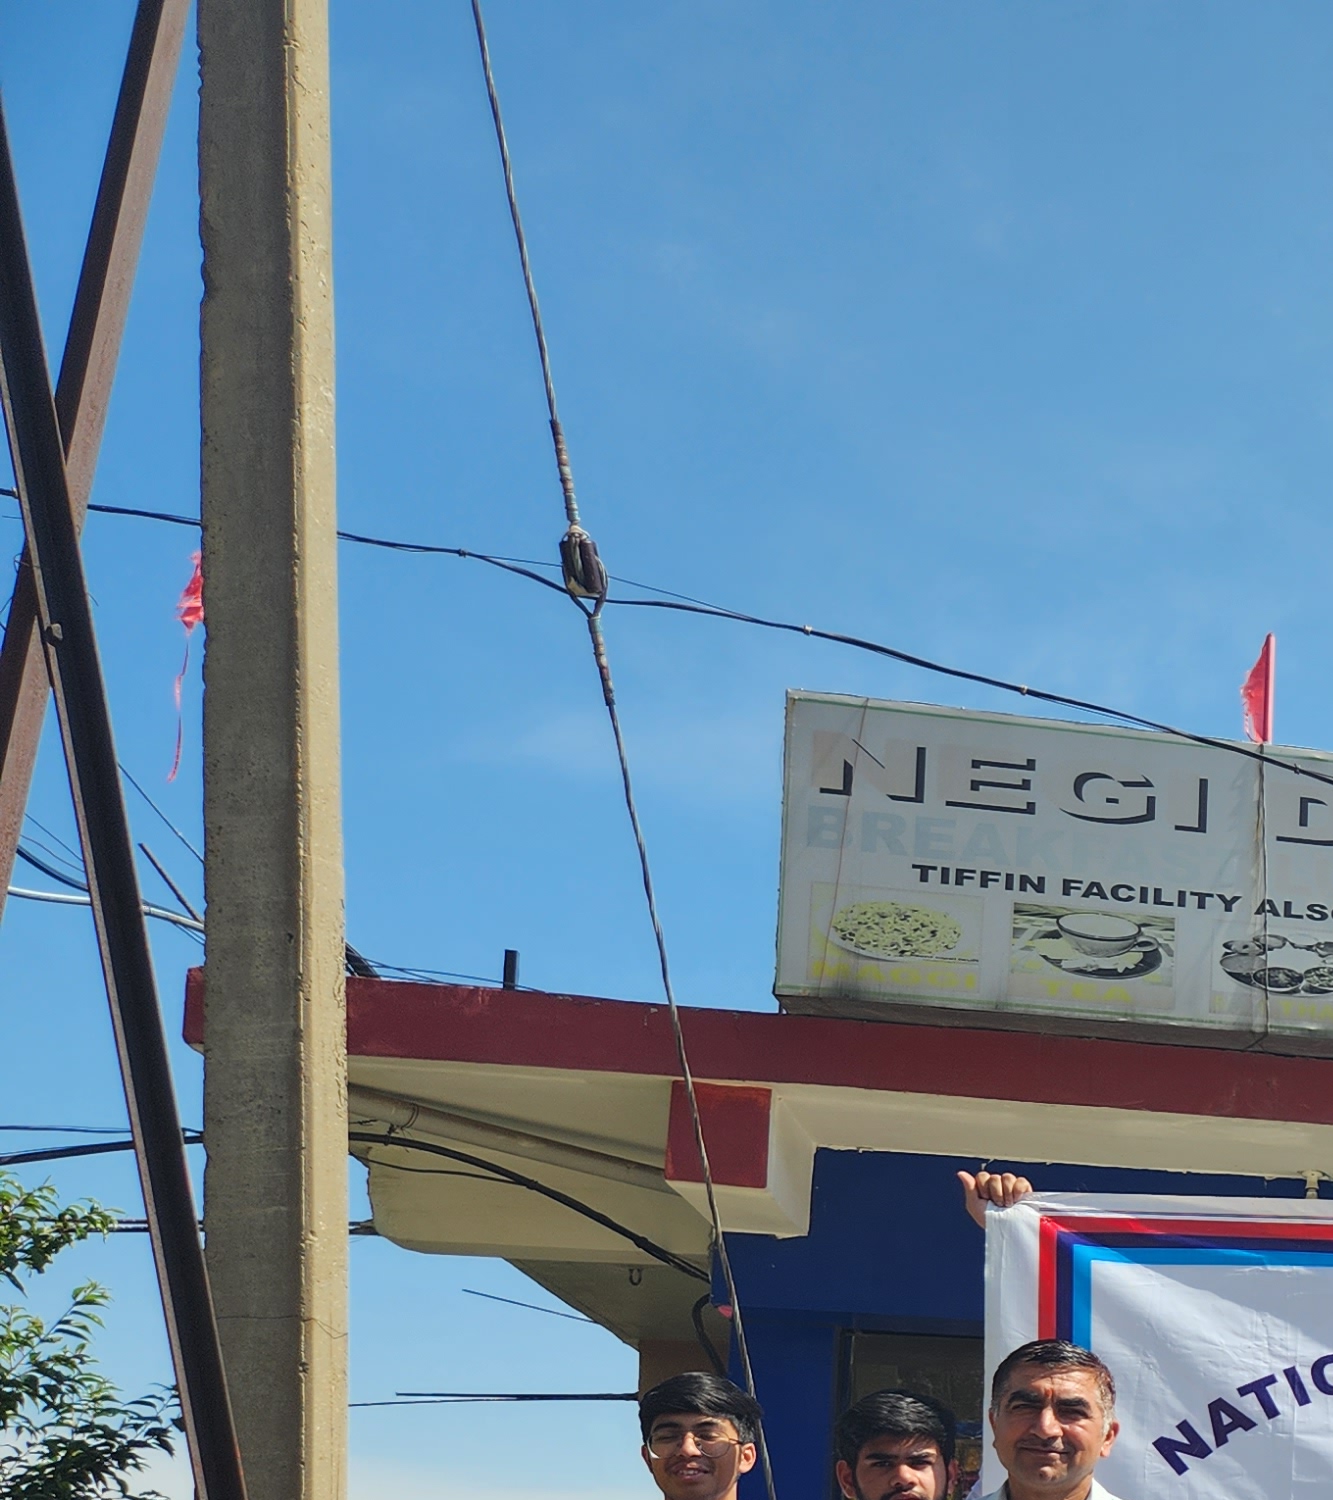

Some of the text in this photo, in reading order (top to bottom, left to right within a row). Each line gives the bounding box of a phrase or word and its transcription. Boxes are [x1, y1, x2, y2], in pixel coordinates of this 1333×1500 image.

[812, 731, 1209, 834] NEGI
[912, 864, 1046, 894] TIFFIN
[1061, 878, 1242, 913] FACILITY
[1039, 979, 1132, 1004] TEA
